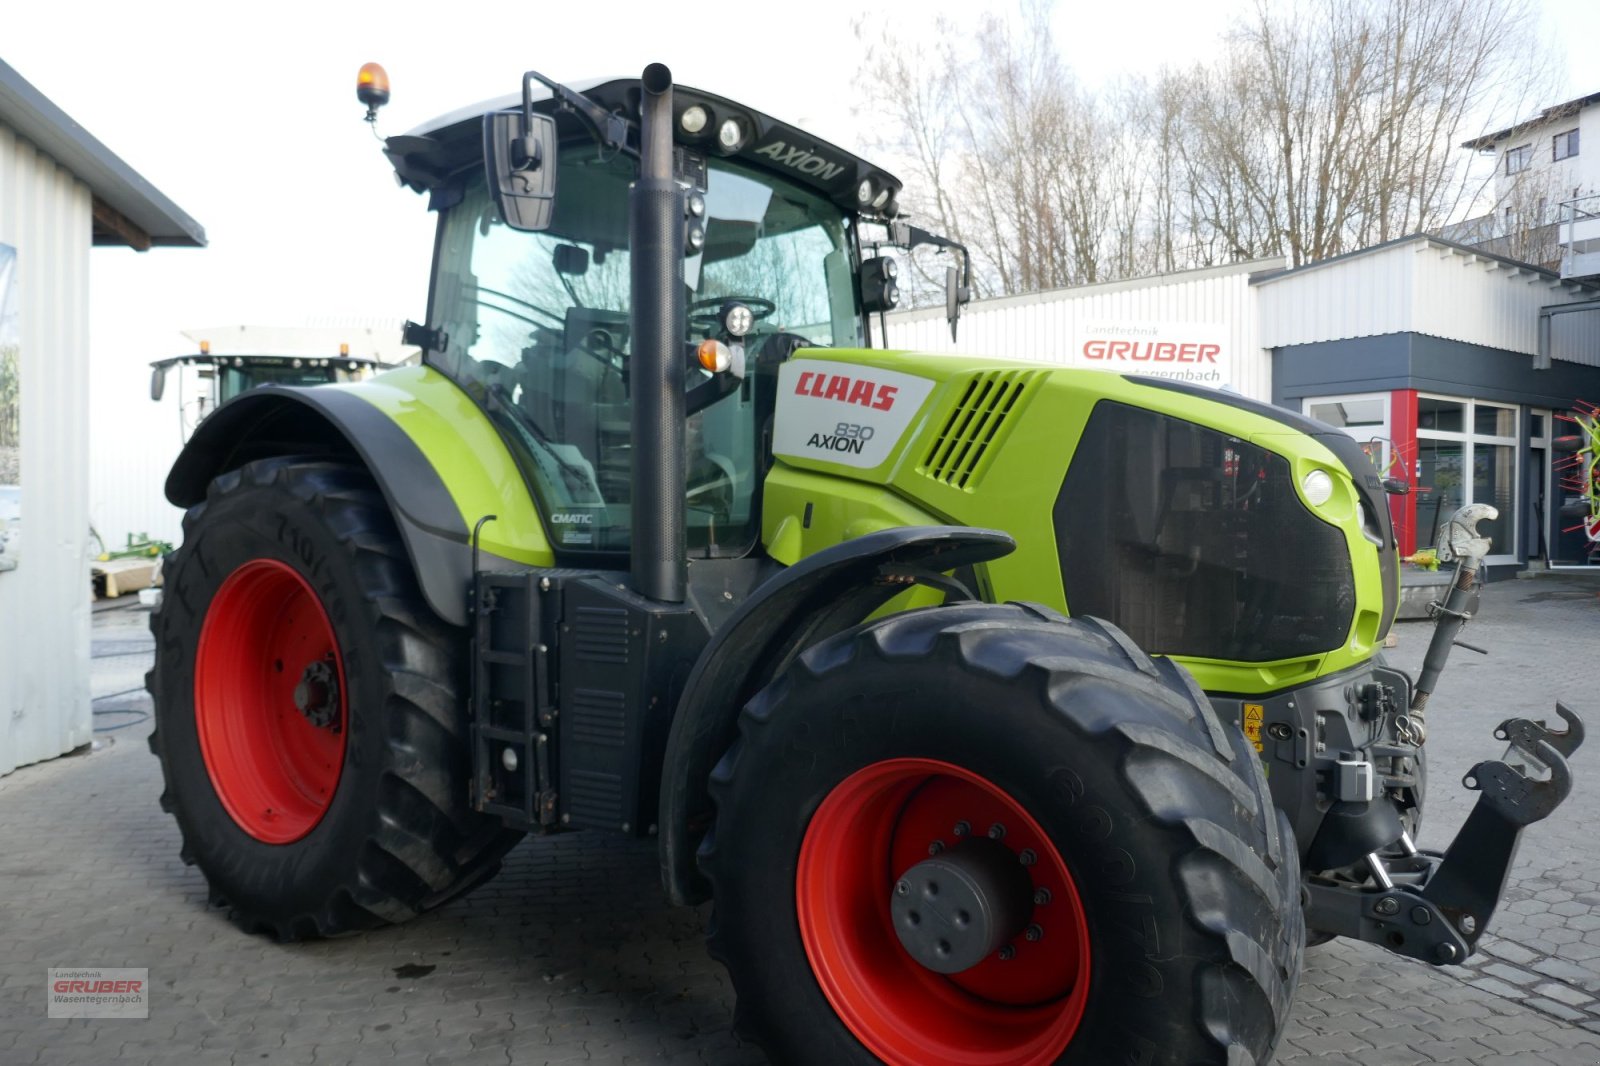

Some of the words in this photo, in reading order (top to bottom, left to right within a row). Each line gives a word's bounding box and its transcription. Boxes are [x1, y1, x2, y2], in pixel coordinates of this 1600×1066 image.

[755, 141, 845, 180] AXION
[1085, 325, 1159, 337] Landtechnik
[1082, 340, 1221, 363] GRUBER
[795, 371, 898, 412] CLAAS
[834, 422, 875, 441] 830
[806, 432, 865, 455] AXION
[551, 513, 593, 524] CMATIC
